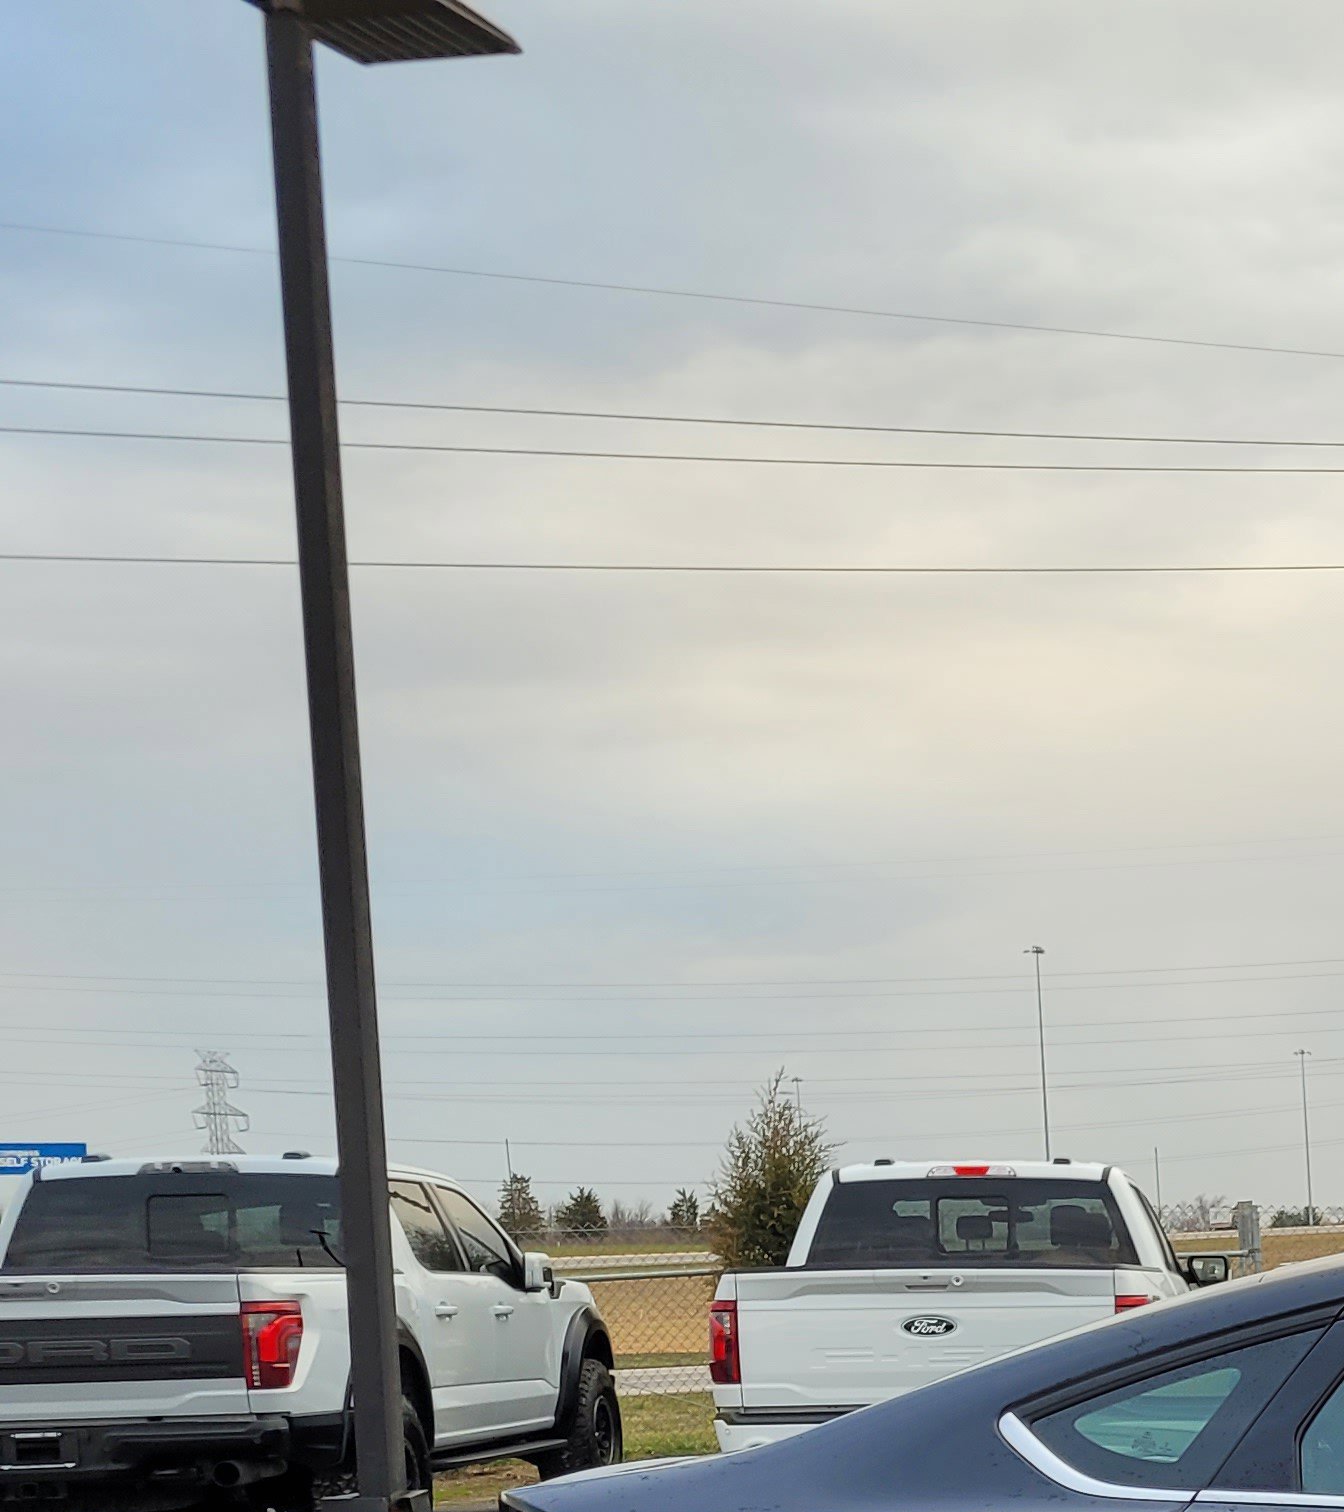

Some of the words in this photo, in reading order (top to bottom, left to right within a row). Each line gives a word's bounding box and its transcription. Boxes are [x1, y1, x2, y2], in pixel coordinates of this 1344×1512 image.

[0, 1157, 28, 1167] SELF
[30, 1157, 83, 1166] STORAG
[910, 1319, 947, 1334] Ford
[0, 1337, 191, 1363] RD
